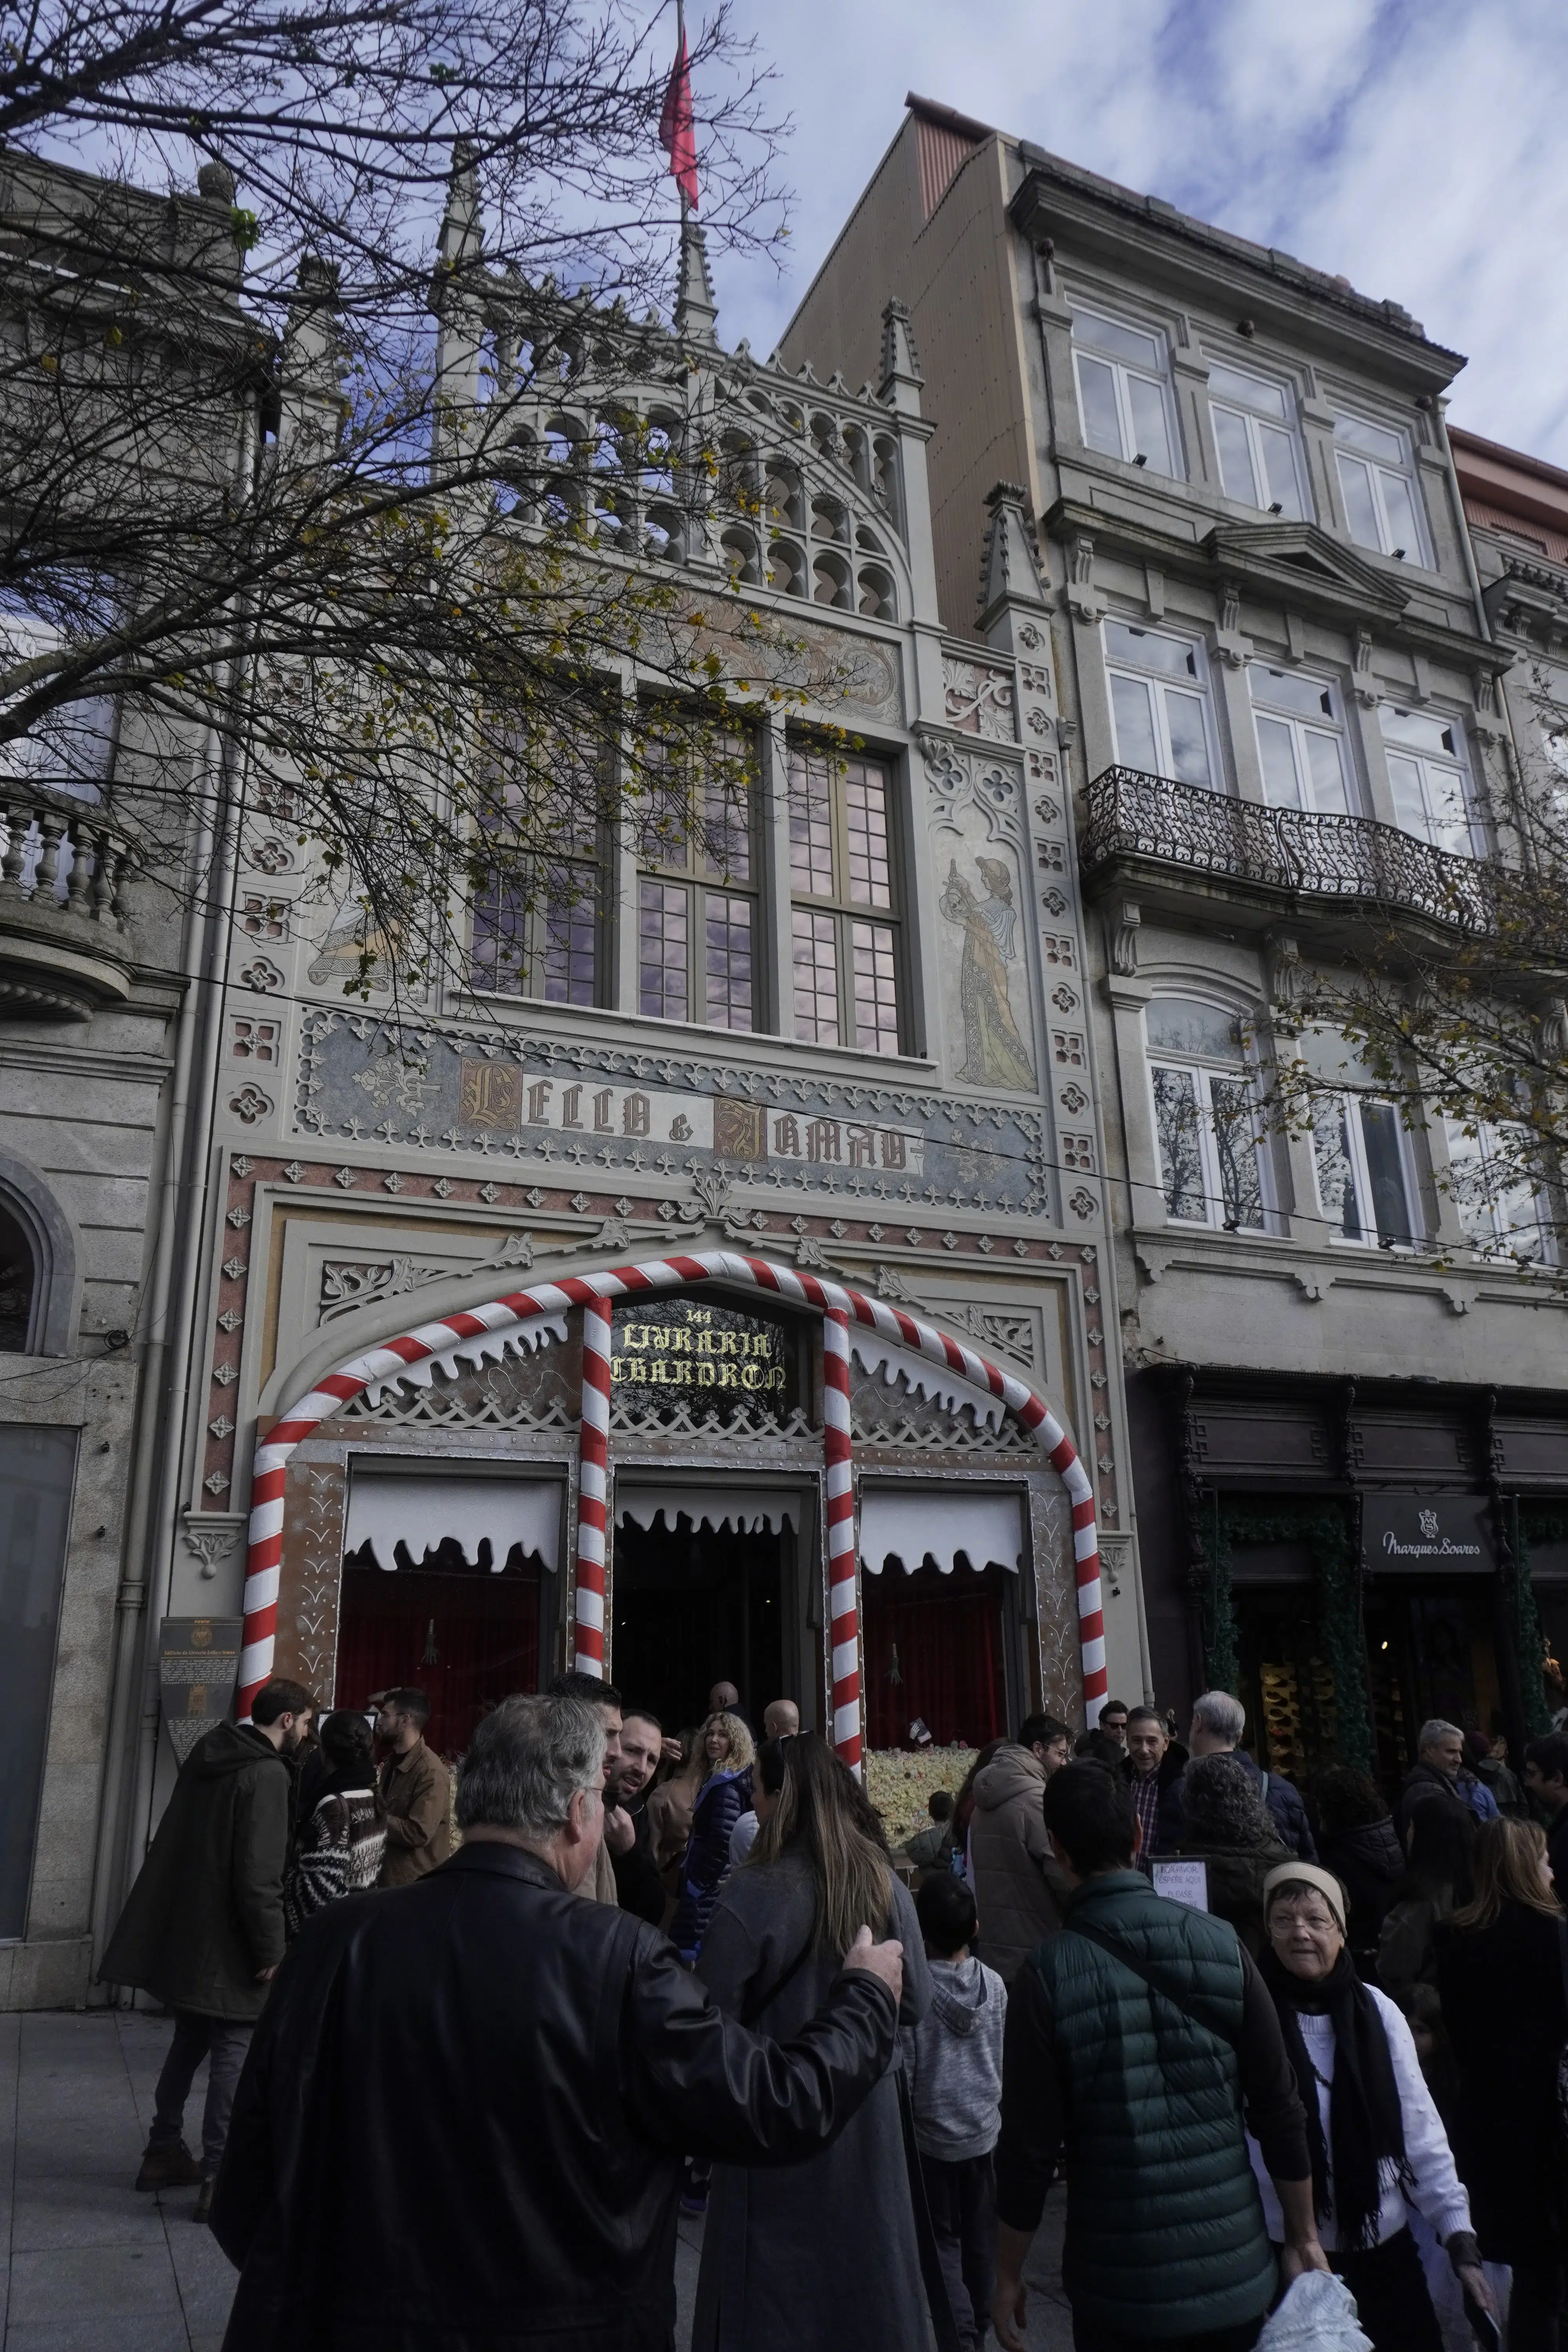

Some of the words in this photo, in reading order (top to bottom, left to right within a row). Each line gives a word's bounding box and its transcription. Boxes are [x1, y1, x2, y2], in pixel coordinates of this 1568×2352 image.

[461, 1062, 650, 1137] LELLO
[669, 1113, 693, 1141] &
[685, 1309, 711, 1323] 144
[622, 1323, 772, 1357] LIVRARIA
[610, 1356, 786, 1390] CHARDRON
[1383, 1532, 1438, 1558] Marques
[1438, 1538, 1480, 1554] Soares
[1185, 1876, 1201, 1885] AQUI
